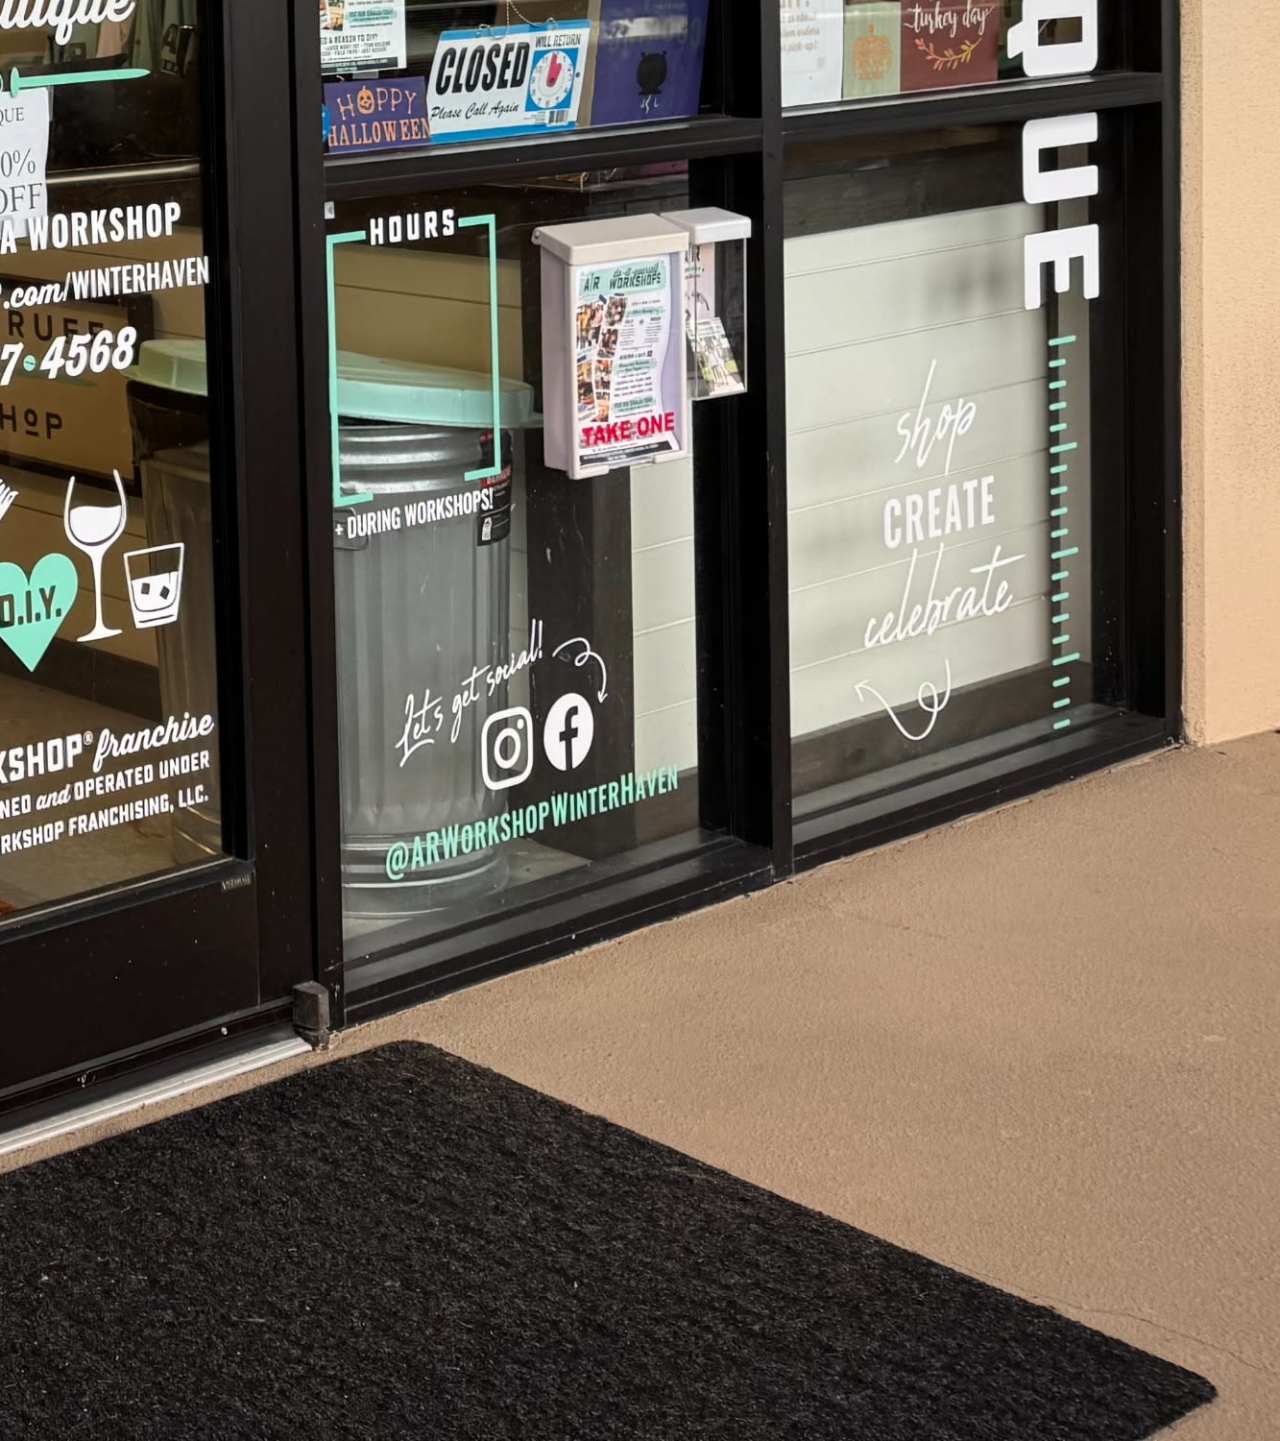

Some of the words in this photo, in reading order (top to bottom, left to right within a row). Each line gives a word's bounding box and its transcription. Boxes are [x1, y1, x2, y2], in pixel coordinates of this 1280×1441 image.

[534, 34, 552, 49] WILL
[552, 31, 582, 47] RETURN
[903, 2, 958, 39] turkey
[436, 41, 531, 97] CLOSED
[430, 105, 462, 121] Please
[464, 103, 487, 120] Call
[487, 101, 519, 117] Again
[0, 219, 19, 255] A
[28, 202, 182, 252] WORKSHOP
[369, 208, 456, 246] HOURS
[609, 273, 661, 290] WORKSHOPS
[582, 420, 632, 448] TAKE
[636, 412, 675, 437] ONE
[894, 359, 976, 476] shop
[346, 506, 402, 539] DURING
[404, 487, 494, 528] WORKSHOPS!
[882, 474, 996, 550] CREATE
[864, 542, 1027, 649] celebrate
[451, 664, 490, 744] get
[487, 618, 544, 697] social!
[92, 712, 215, 773] franchise
[35, 783, 72, 811] and
[73, 767, 155, 802] OPERATED
[158, 750, 211, 780] UNDER
[67, 799, 176, 839] FRANCHISING,
[177, 789, 210, 817] LLC.
